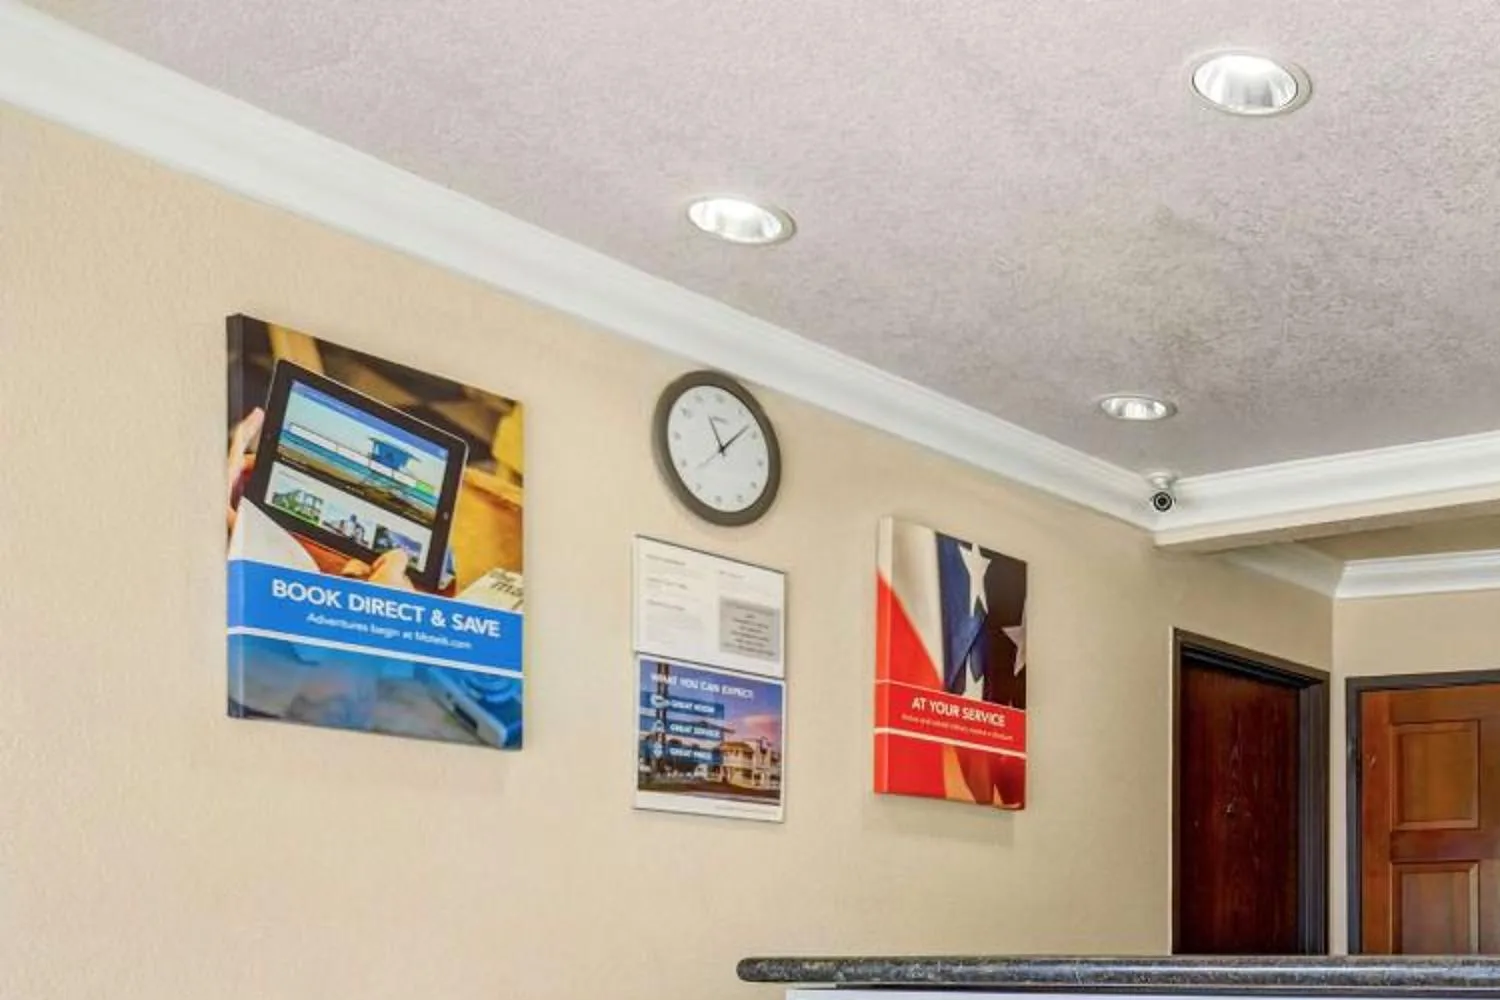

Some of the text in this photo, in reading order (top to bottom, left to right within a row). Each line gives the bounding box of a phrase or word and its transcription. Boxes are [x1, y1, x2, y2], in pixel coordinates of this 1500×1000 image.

[272, 578, 501, 638] BOOK DIRECT & SAVE
[911, 697, 927, 712] AT
[928, 699, 960, 718] YOUR
[961, 707, 1006, 727] SERVICE
